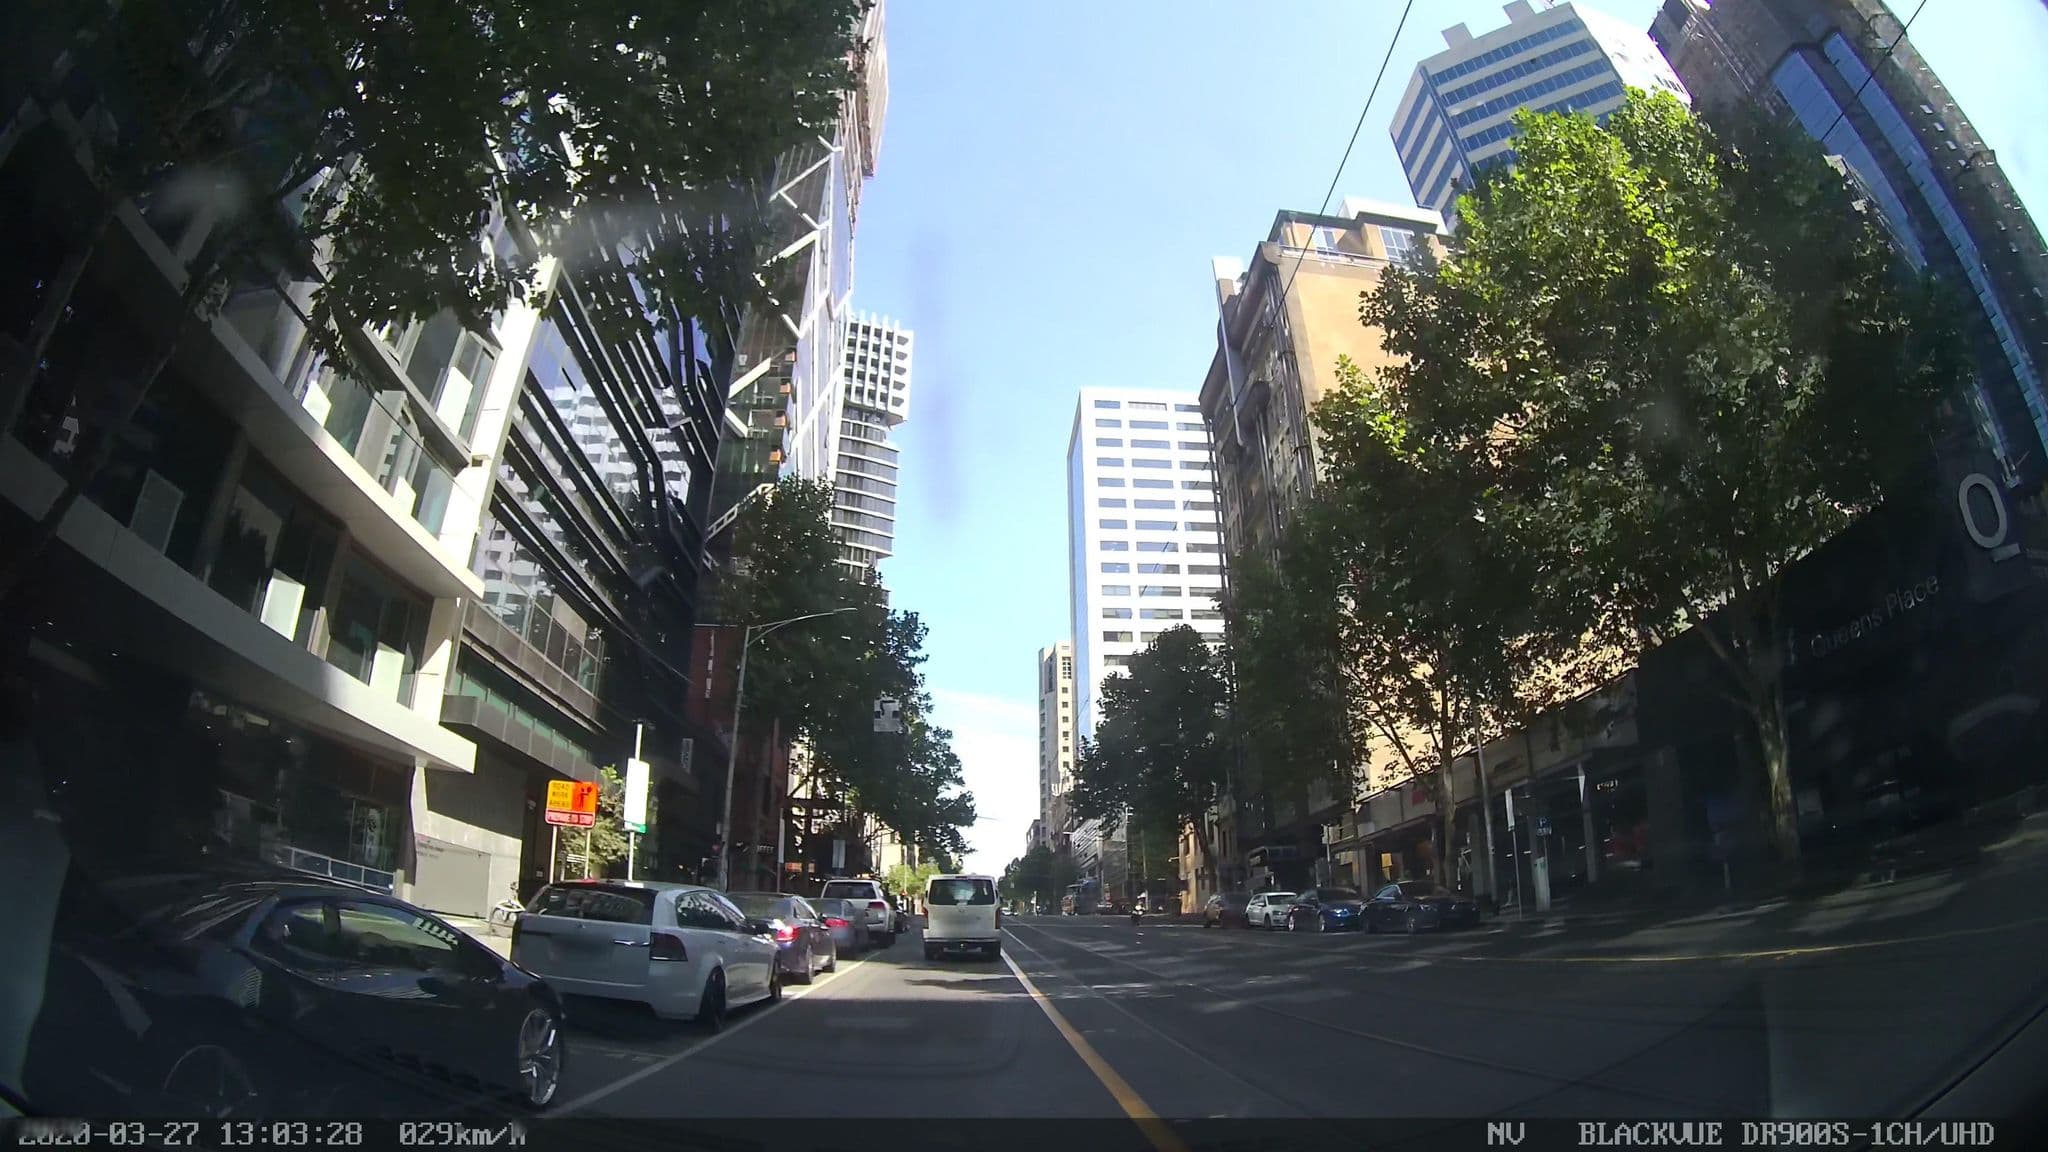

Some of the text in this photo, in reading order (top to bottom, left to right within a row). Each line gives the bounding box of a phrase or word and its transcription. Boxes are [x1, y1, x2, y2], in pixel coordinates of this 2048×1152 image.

[1958, 472, 2022, 563] Q
[1809, 575, 1940, 658] Queens Place
